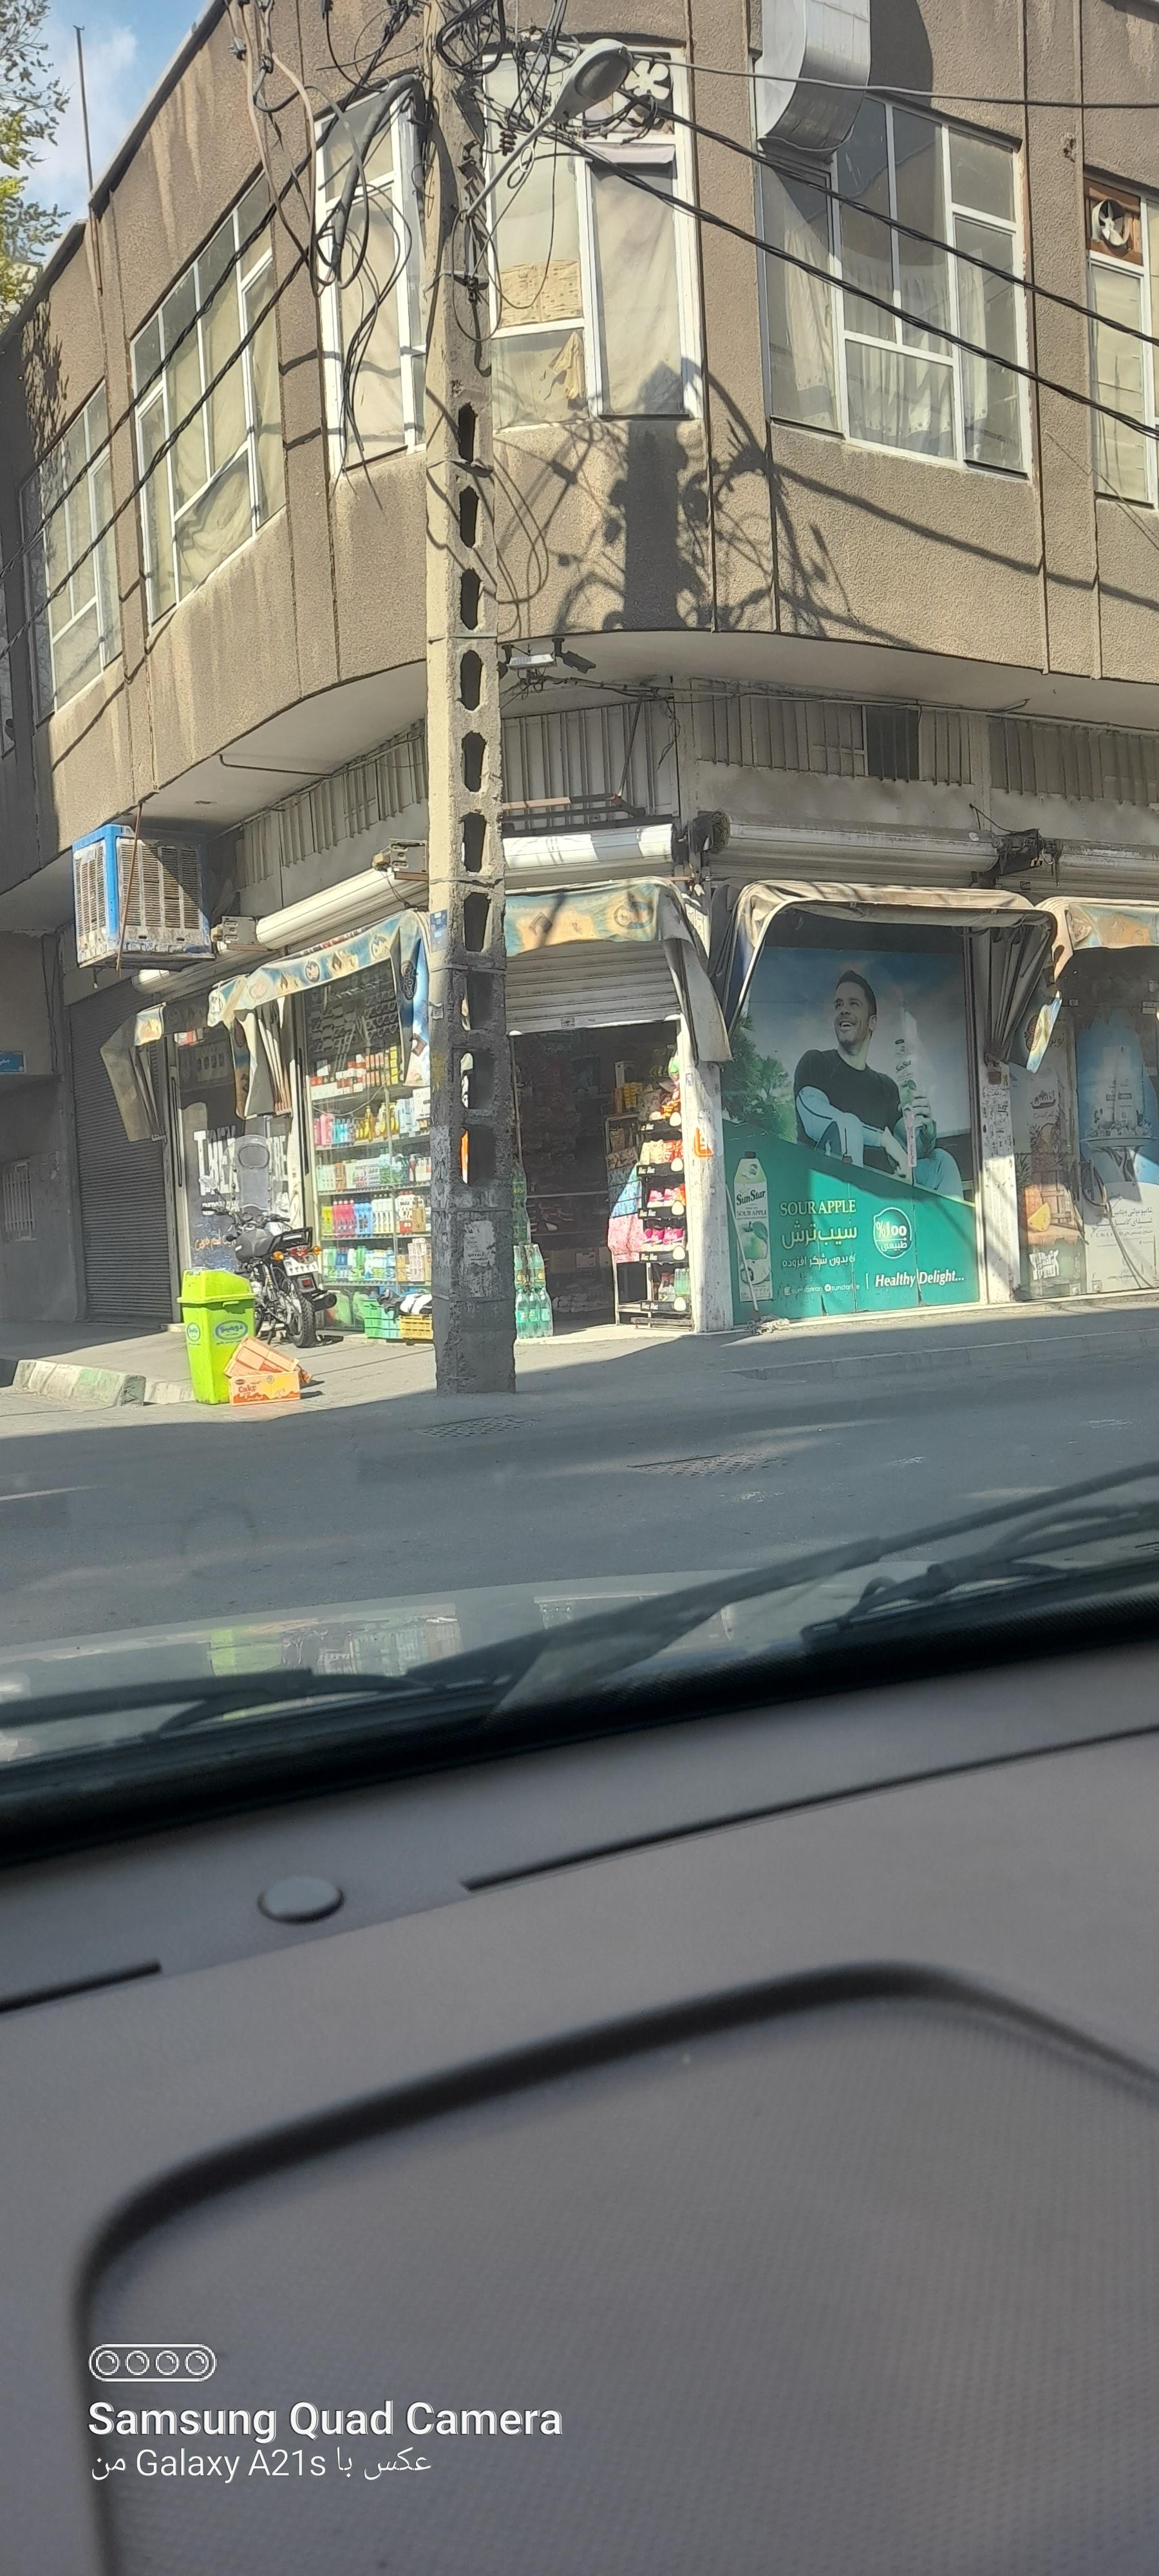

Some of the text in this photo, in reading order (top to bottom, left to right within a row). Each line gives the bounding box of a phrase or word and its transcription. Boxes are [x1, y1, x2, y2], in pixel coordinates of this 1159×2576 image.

[737, 1189, 766, 1206] SunStar
[780, 1200, 856, 1217] SOUR APPLE
[782, 1220, 858, 1249] سیب ترش
[881, 1240, 907, 1251] طبیعی
[782, 1253, 849, 1269] بدون شکر افزوده
[875, 1272, 916, 1288] Healthy
